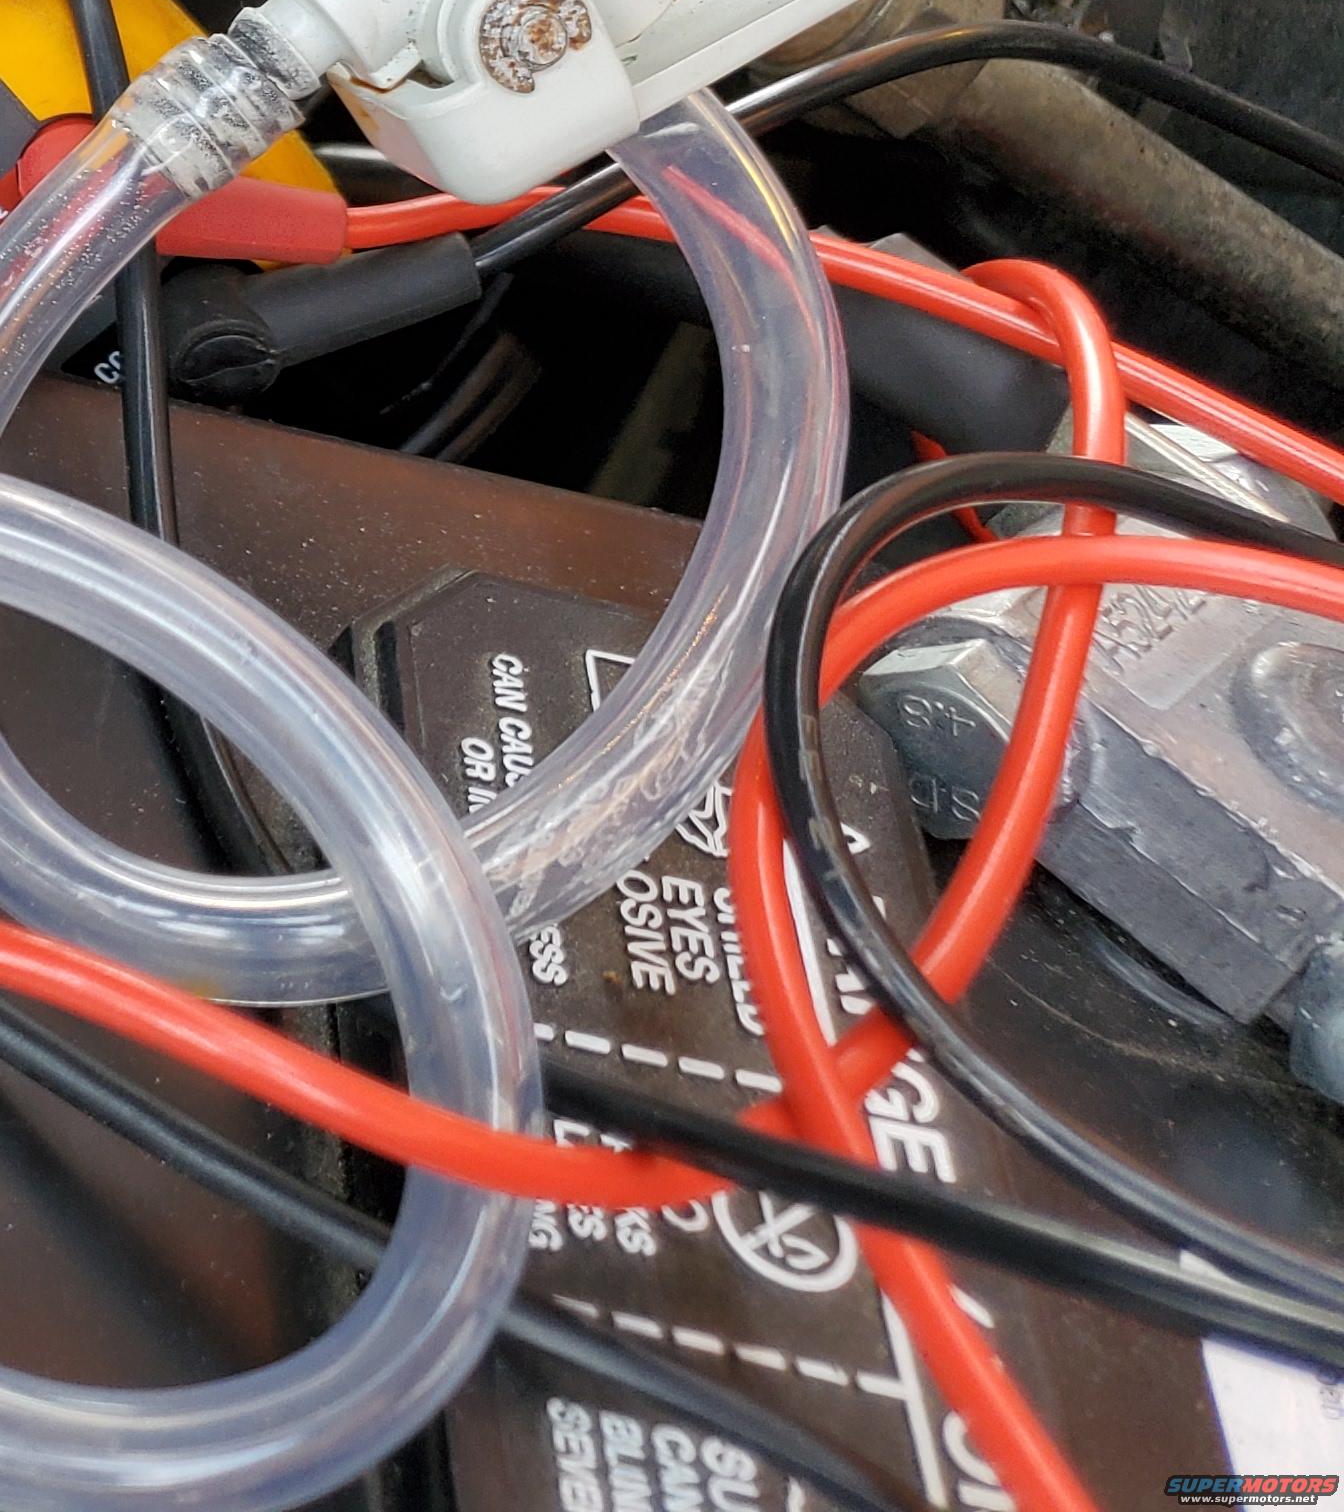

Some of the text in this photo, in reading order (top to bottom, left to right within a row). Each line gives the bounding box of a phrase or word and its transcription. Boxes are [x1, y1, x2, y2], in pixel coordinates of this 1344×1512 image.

[492, 653, 528, 713] CAN
[462, 737, 496, 782] OR
[662, 874, 720, 984] EYES
